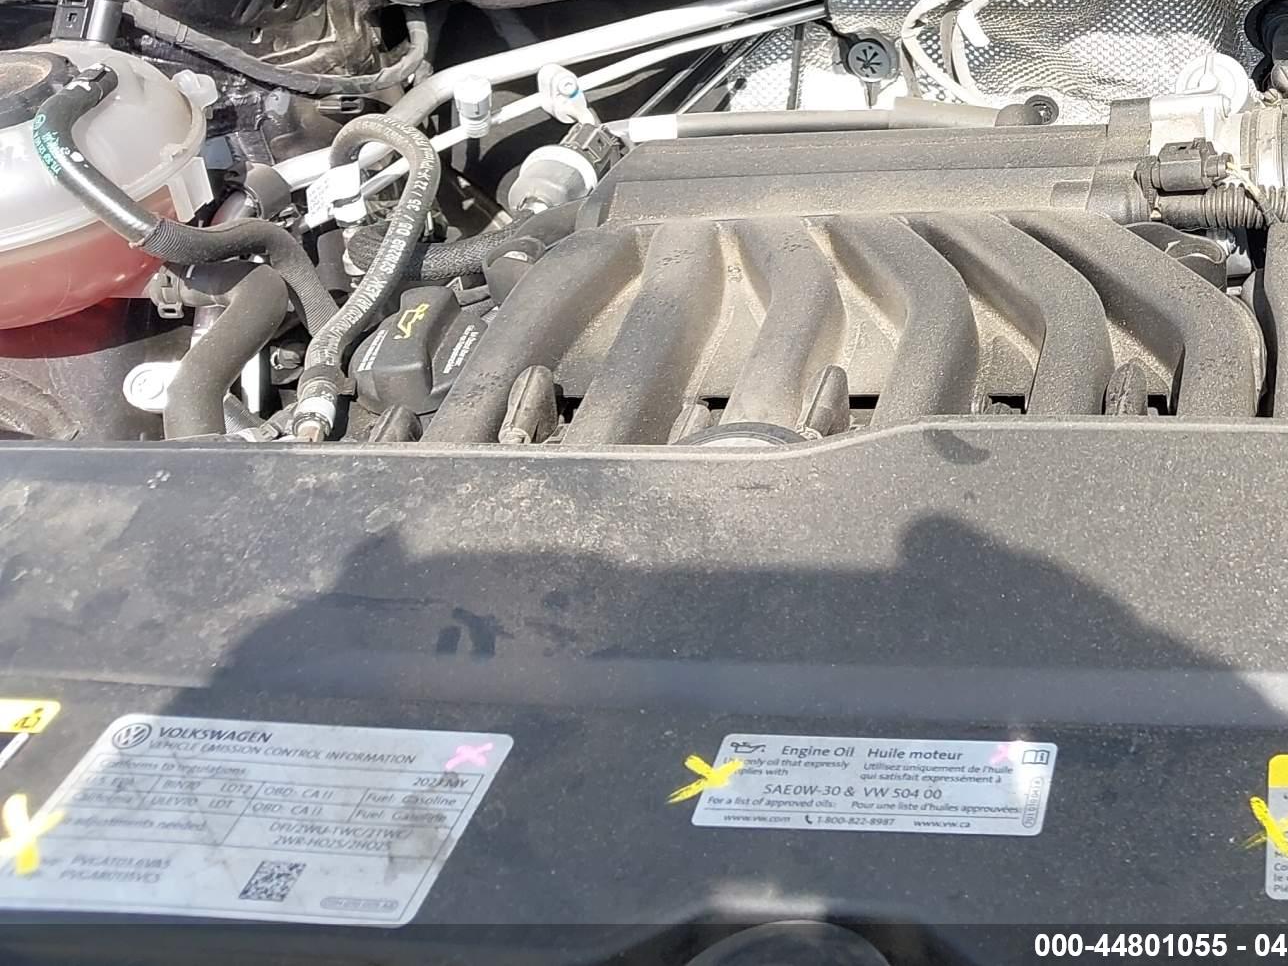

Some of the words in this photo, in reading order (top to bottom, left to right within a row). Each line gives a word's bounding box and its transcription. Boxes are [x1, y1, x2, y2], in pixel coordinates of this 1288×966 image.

[157, 726, 274, 744] VOLKSWAGEN
[148, 739, 198, 751] VEHICLE
[199, 742, 262, 755] EMISSION
[263, 745, 322, 760] CONTROL
[325, 750, 418, 765] INFORMATION
[781, 745, 831, 759] Engine
[833, 746, 856, 758] Oil
[867, 747, 906, 760] Huile
[908, 749, 964, 762] moteur
[160, 762, 176, 772] to
[176, 763, 247, 777] regulations
[743, 758, 765, 769] only
[766, 757, 780, 767] oil
[781, 759, 802, 768] that
[803, 760, 851, 771] expressly
[863, 762, 903, 773] Utilisez
[902, 763, 966, 775] uniquement
[967, 765, 982, 774] de
[983, 765, 1014, 776] l'huile
[765, 768, 790, 777] with
[859, 772, 878, 782] qui
[878, 772, 921, 783] satisfait
[921, 773, 995, 785] expressément
[400, 794, 458, 807] Gasoline
[762, 783, 842, 797] SAE0W-30
[843, 786, 857, 797] &
[863, 787, 889, 799] VW
[891, 787, 921, 800] 504
[923, 789, 943, 801] 00
[707, 795, 724, 806] For
[735, 796, 752, 806] list
[752, 797, 765, 807] of
[766, 798, 815, 810] approved
[851, 801, 875, 811] Pour
[875, 803, 897, 812] une
[897, 802, 919, 812] liste
[920, 802, 959, 813] d'huiles
[156, 819, 209, 832] needed
[1273, 873, 1284, 883] le
